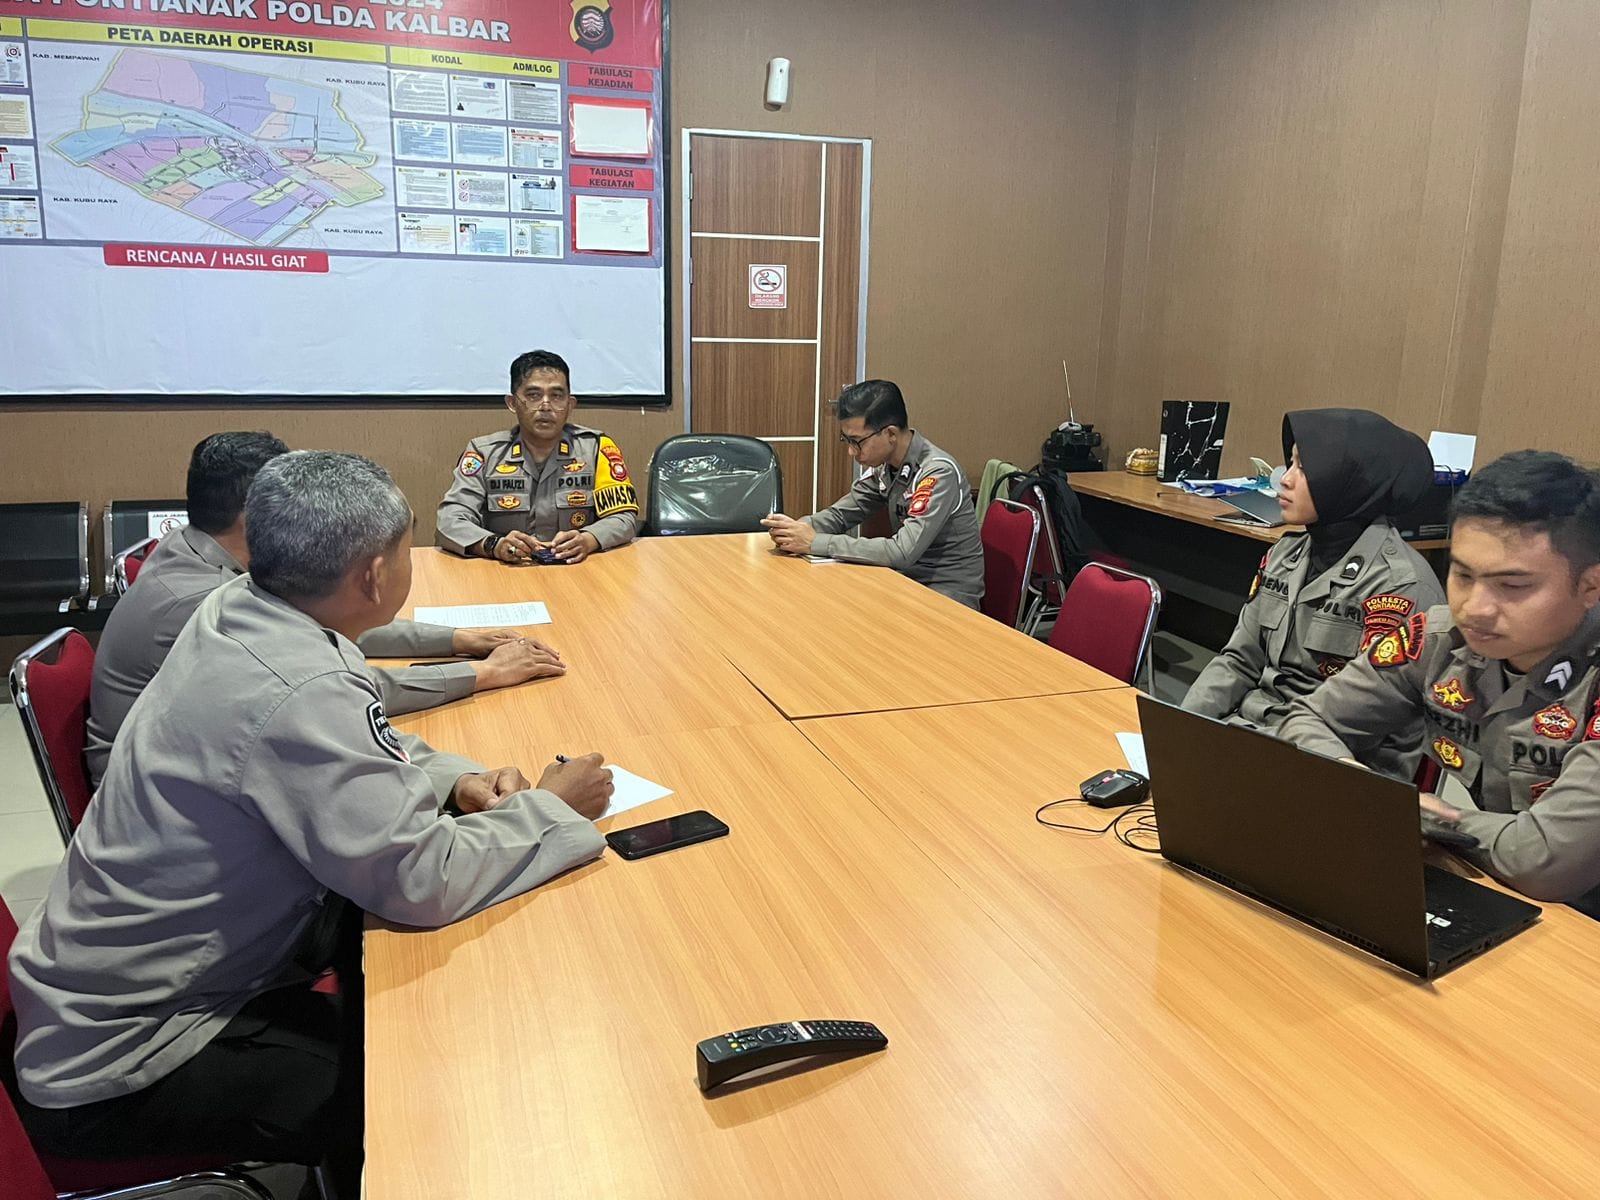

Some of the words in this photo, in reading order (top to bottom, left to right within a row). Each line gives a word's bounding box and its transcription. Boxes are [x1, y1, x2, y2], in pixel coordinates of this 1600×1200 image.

[268, 0, 376, 29] POLDA
[385, 10, 511, 42] KALBAR
[107, 27, 154, 41] PETA
[160, 30, 232, 47] DAERAH
[238, 36, 314, 53] OPERASI
[431, 54, 463, 65] KODAL
[513, 62, 553, 73] ADM/LOG
[587, 66, 633, 78] TABULASI
[588, 78, 634, 89] KEJADIAN
[589, 167, 634, 178] TABULASI
[589, 178, 635, 188] KEGIATAN
[126, 249, 206, 265] RENCANA
[222, 252, 268, 267] HASIL
[271, 254, 307, 268] GIAT
[558, 476, 592, 487] POLRI
[1366, 596, 1409, 608] POLRESTA
